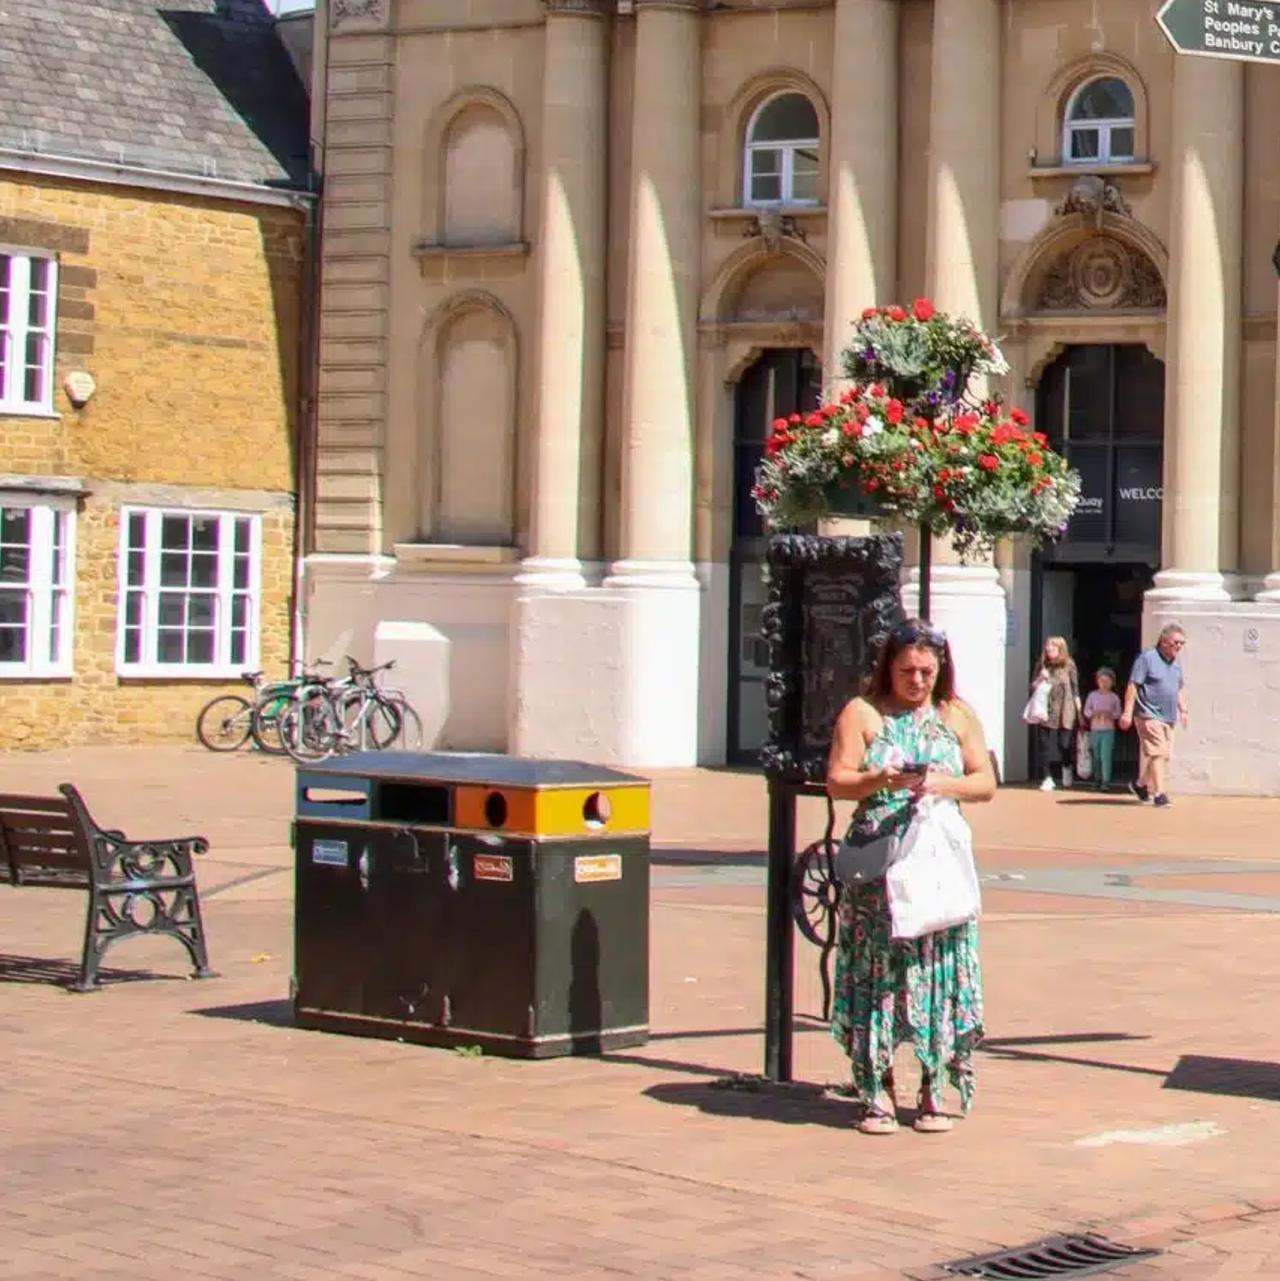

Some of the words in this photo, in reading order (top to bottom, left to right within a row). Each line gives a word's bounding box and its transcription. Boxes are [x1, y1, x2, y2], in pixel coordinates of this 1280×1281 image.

[1203, 0, 1219, 14] St
[1227, 1, 1274, 21] Mary's
[1204, 16, 1260, 35] Peoples
[1204, 32, 1263, 55] Banbury
